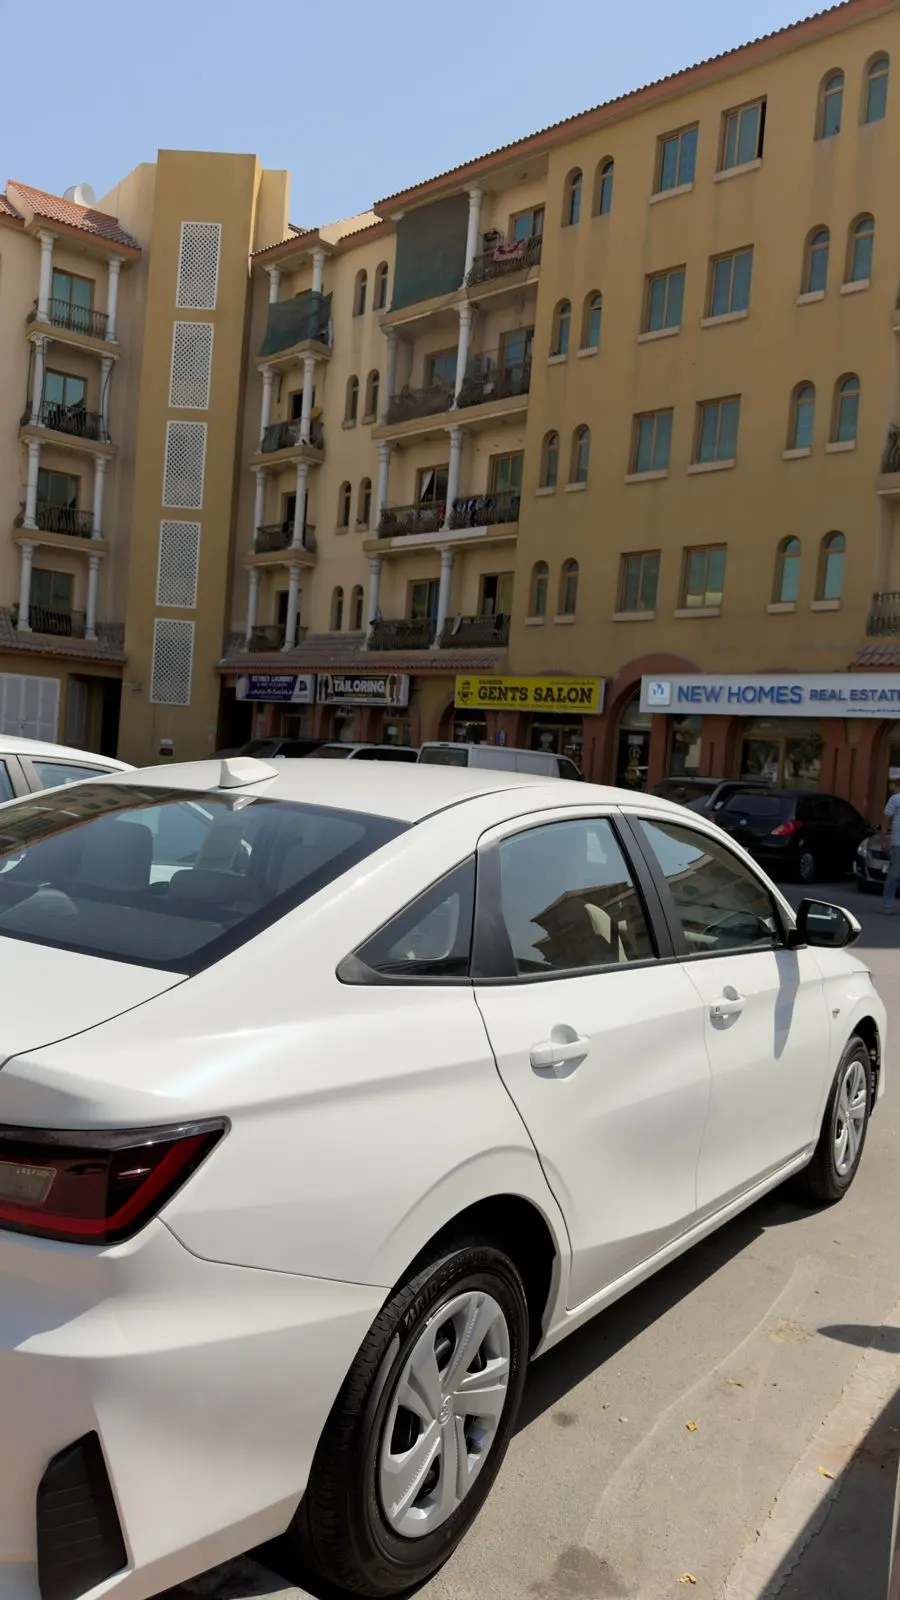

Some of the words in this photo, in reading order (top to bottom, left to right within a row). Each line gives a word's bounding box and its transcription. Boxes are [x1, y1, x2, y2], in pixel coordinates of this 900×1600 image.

[333, 680, 385, 693] TAILORING
[478, 686, 528, 702] GENTS
[534, 687, 593, 704] SALON
[677, 685, 724, 704] NEW
[728, 685, 803, 704] HOMES
[809, 689, 846, 701] REAL
